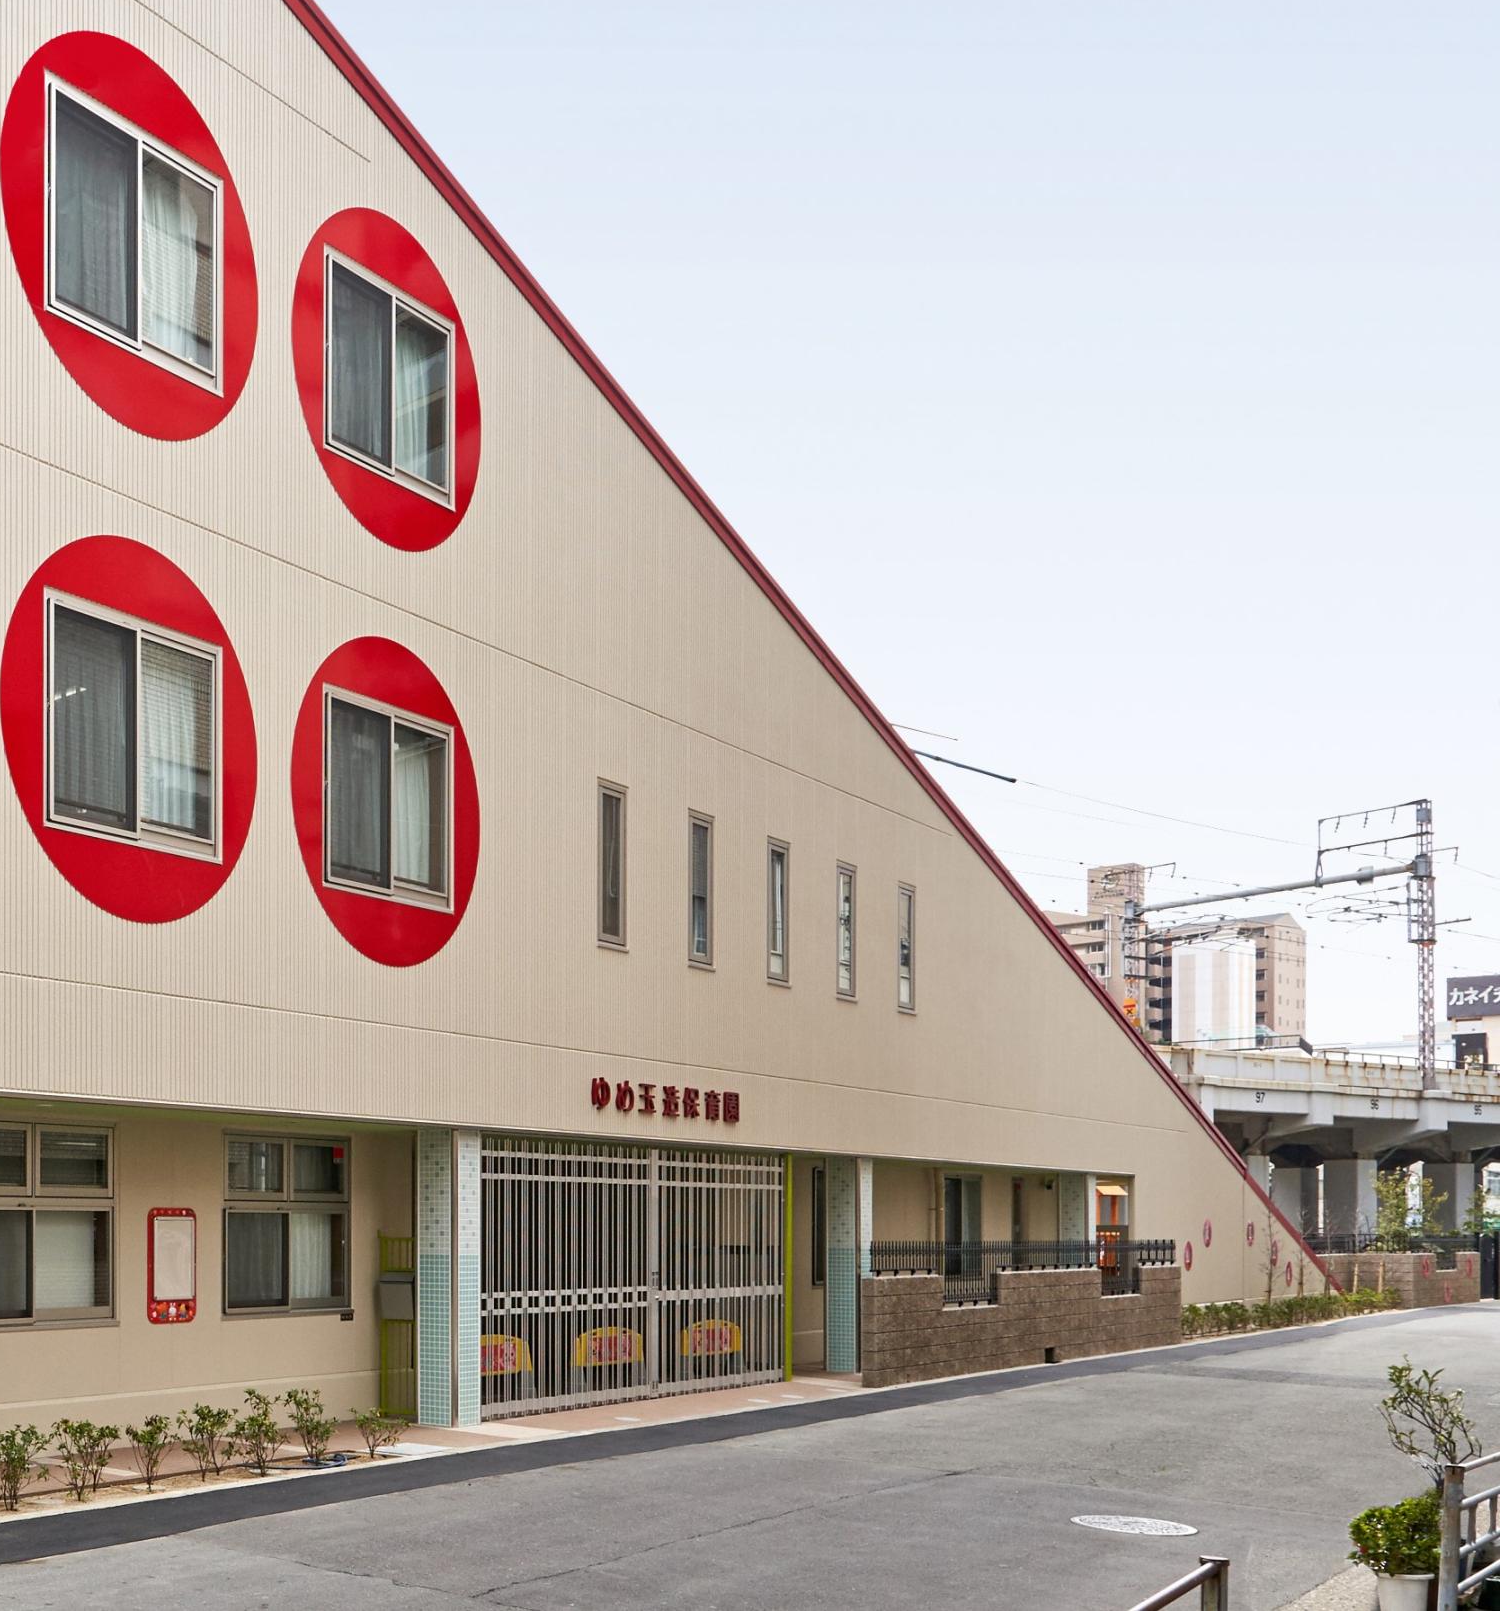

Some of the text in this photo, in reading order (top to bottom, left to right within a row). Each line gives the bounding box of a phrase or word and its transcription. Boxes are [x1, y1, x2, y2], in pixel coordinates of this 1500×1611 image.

[591, 1077, 740, 1123] ゆめ玉造保育園
[1255, 1091, 1266, 1103] 97
